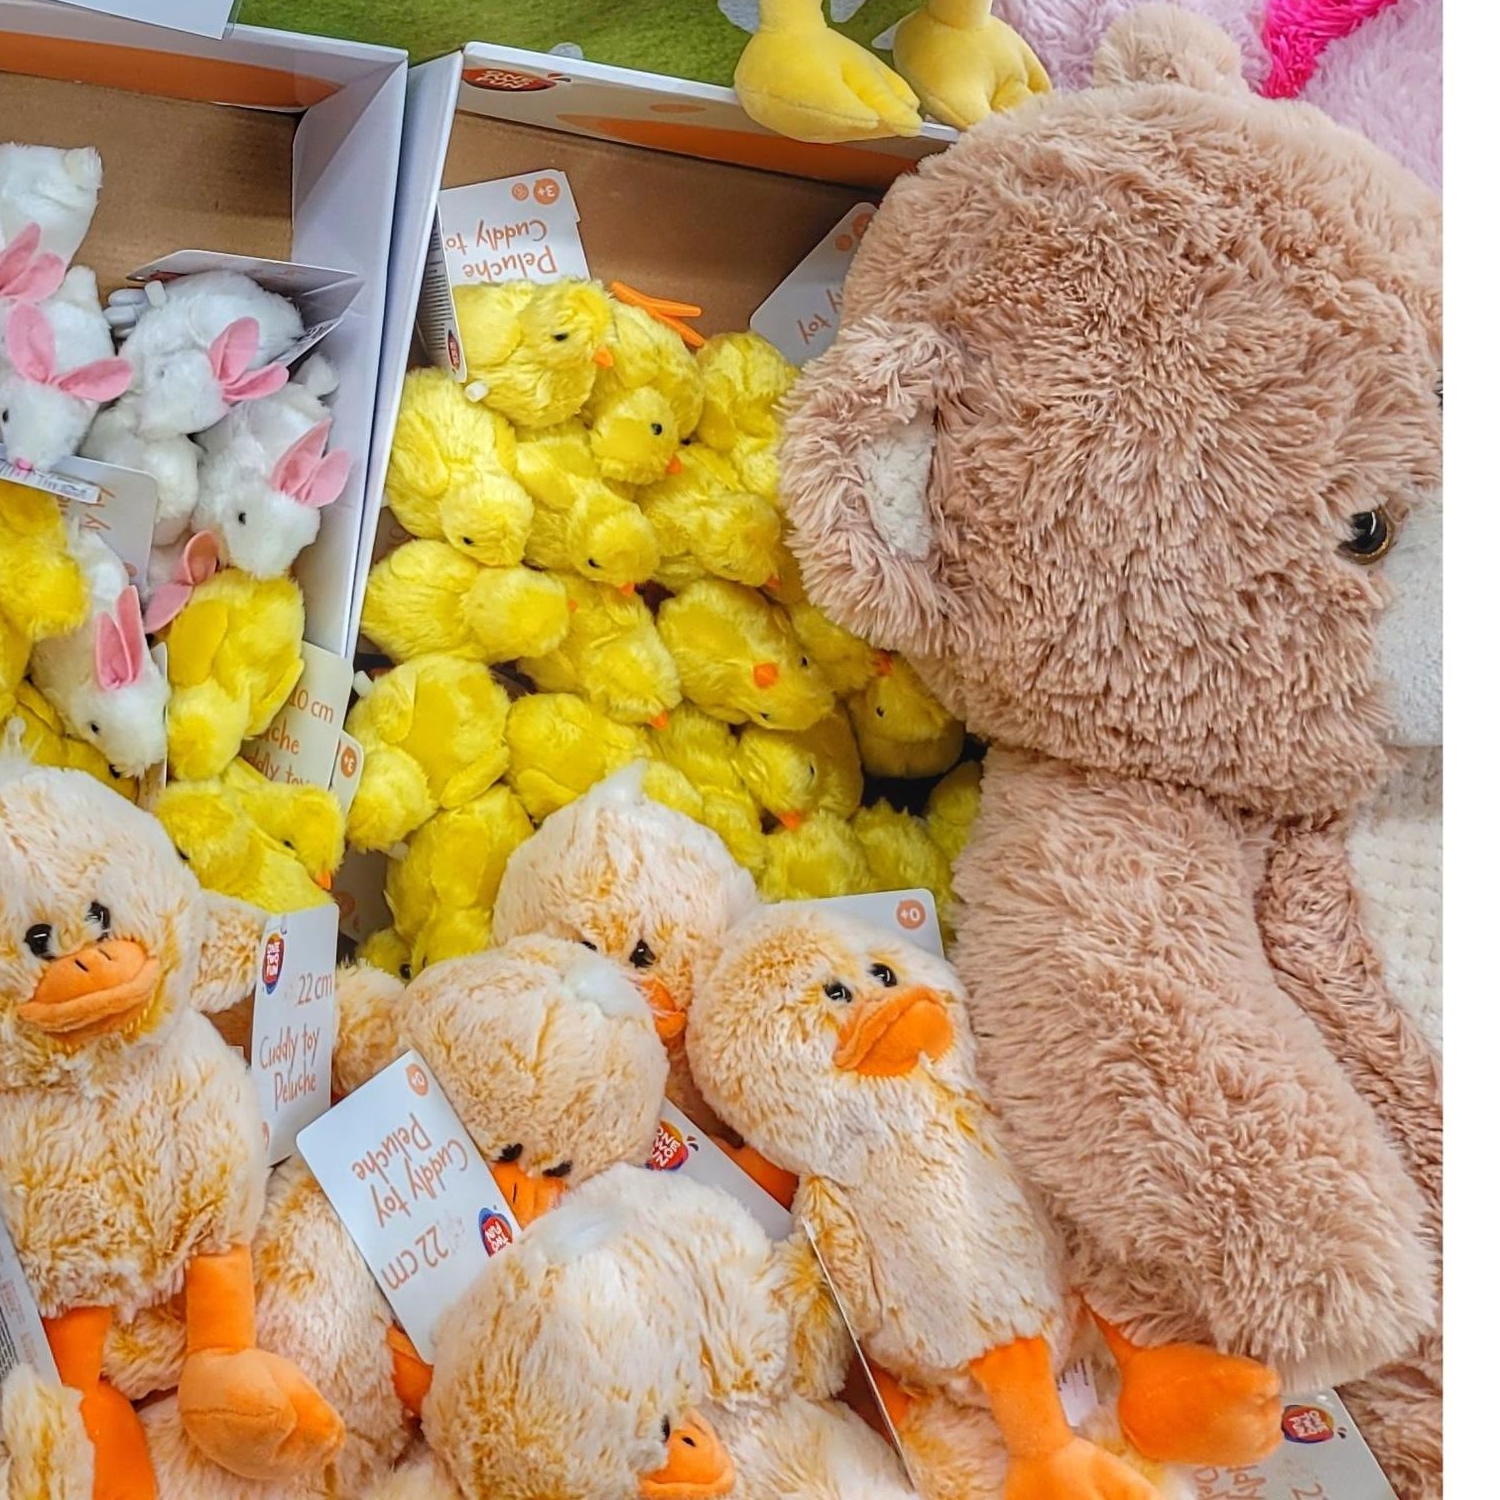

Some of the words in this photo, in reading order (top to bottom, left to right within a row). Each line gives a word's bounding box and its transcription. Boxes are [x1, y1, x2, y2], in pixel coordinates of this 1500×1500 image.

[445, 232, 468, 255] to
[476, 219, 547, 251] Cuddly
[462, 245, 559, 284] Peluche
[797, 313, 832, 345] toy
[311, 701, 334, 724] cm
[296, 972, 314, 1006] 22
[314, 972, 333, 999] cm
[259, 1025, 298, 1076] Cuddly
[301, 1022, 321, 1067] toy
[274, 1060, 317, 1112] Peluche
[352, 1112, 432, 1184] Peluche
[404, 1139, 468, 1200] Cuddly
[370, 1184, 412, 1228] toy
[415, 1226, 448, 1267] 22
[381, 1249, 418, 1290] cm
